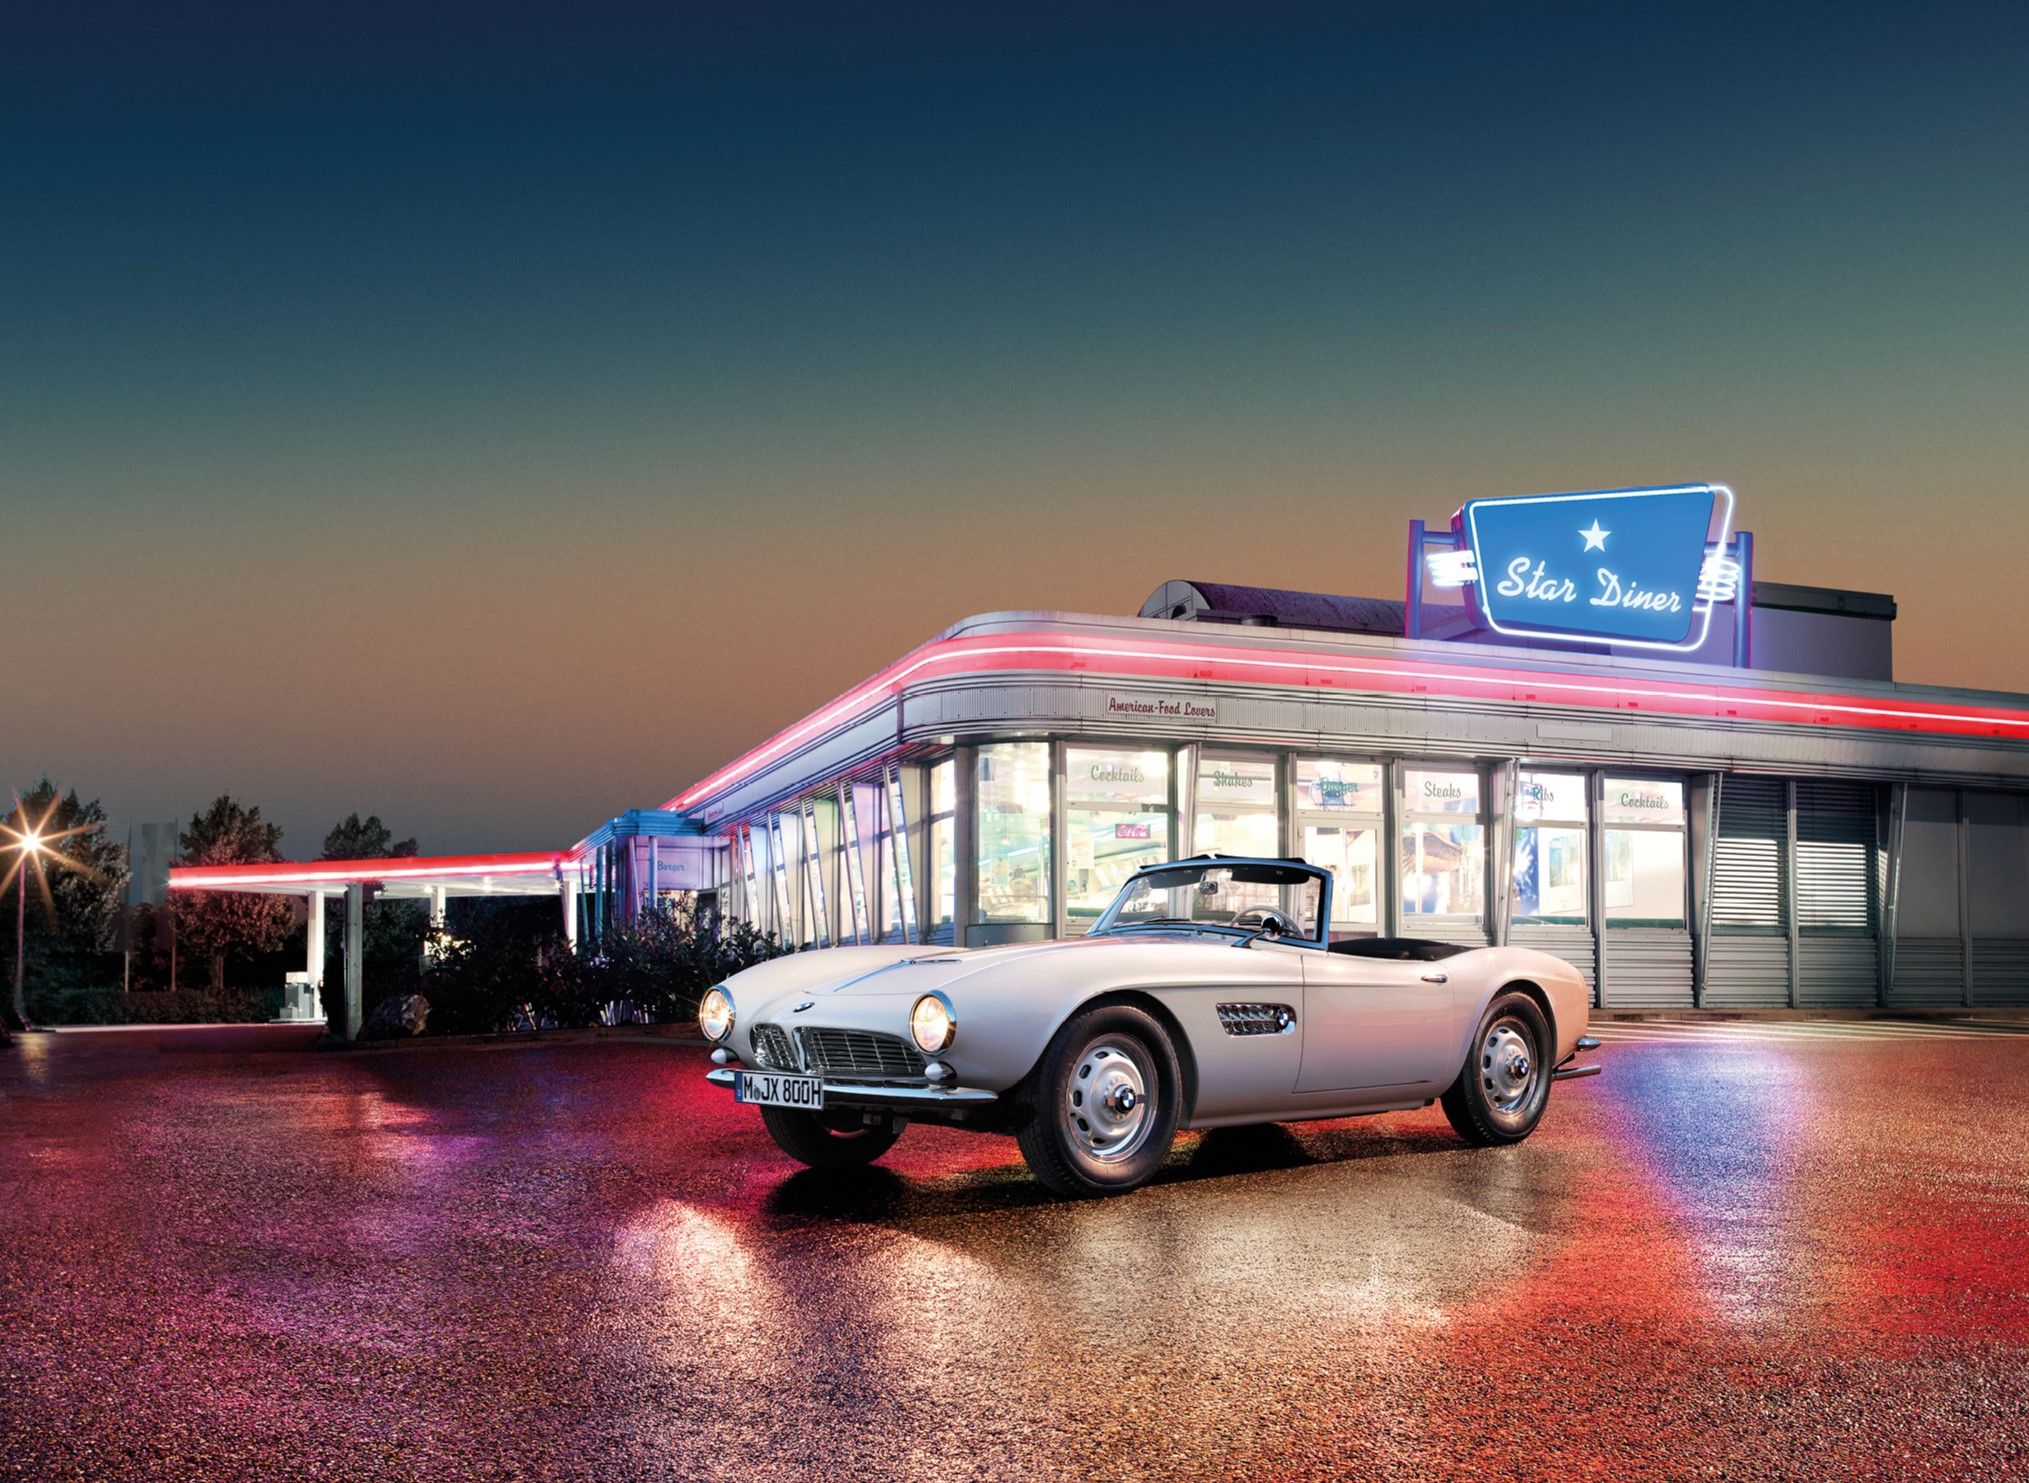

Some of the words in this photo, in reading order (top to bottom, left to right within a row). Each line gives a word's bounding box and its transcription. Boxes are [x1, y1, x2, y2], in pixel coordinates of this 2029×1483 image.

[1497, 556, 1577, 602] Star
[1589, 567, 1681, 612] Diner
[1108, 697, 1181, 714] American-Food
[1184, 702, 1215, 717] Lovers
[1091, 765, 1144, 782] Cocktails
[1213, 771, 1253, 787] Shakes
[1424, 781, 1461, 798] Steaks
[1533, 785, 1554, 801] Ribs
[1621, 792, 1669, 809] Cocktails
[761, 1077, 779, 1102] JX
[783, 1079, 821, 1105] 800H
